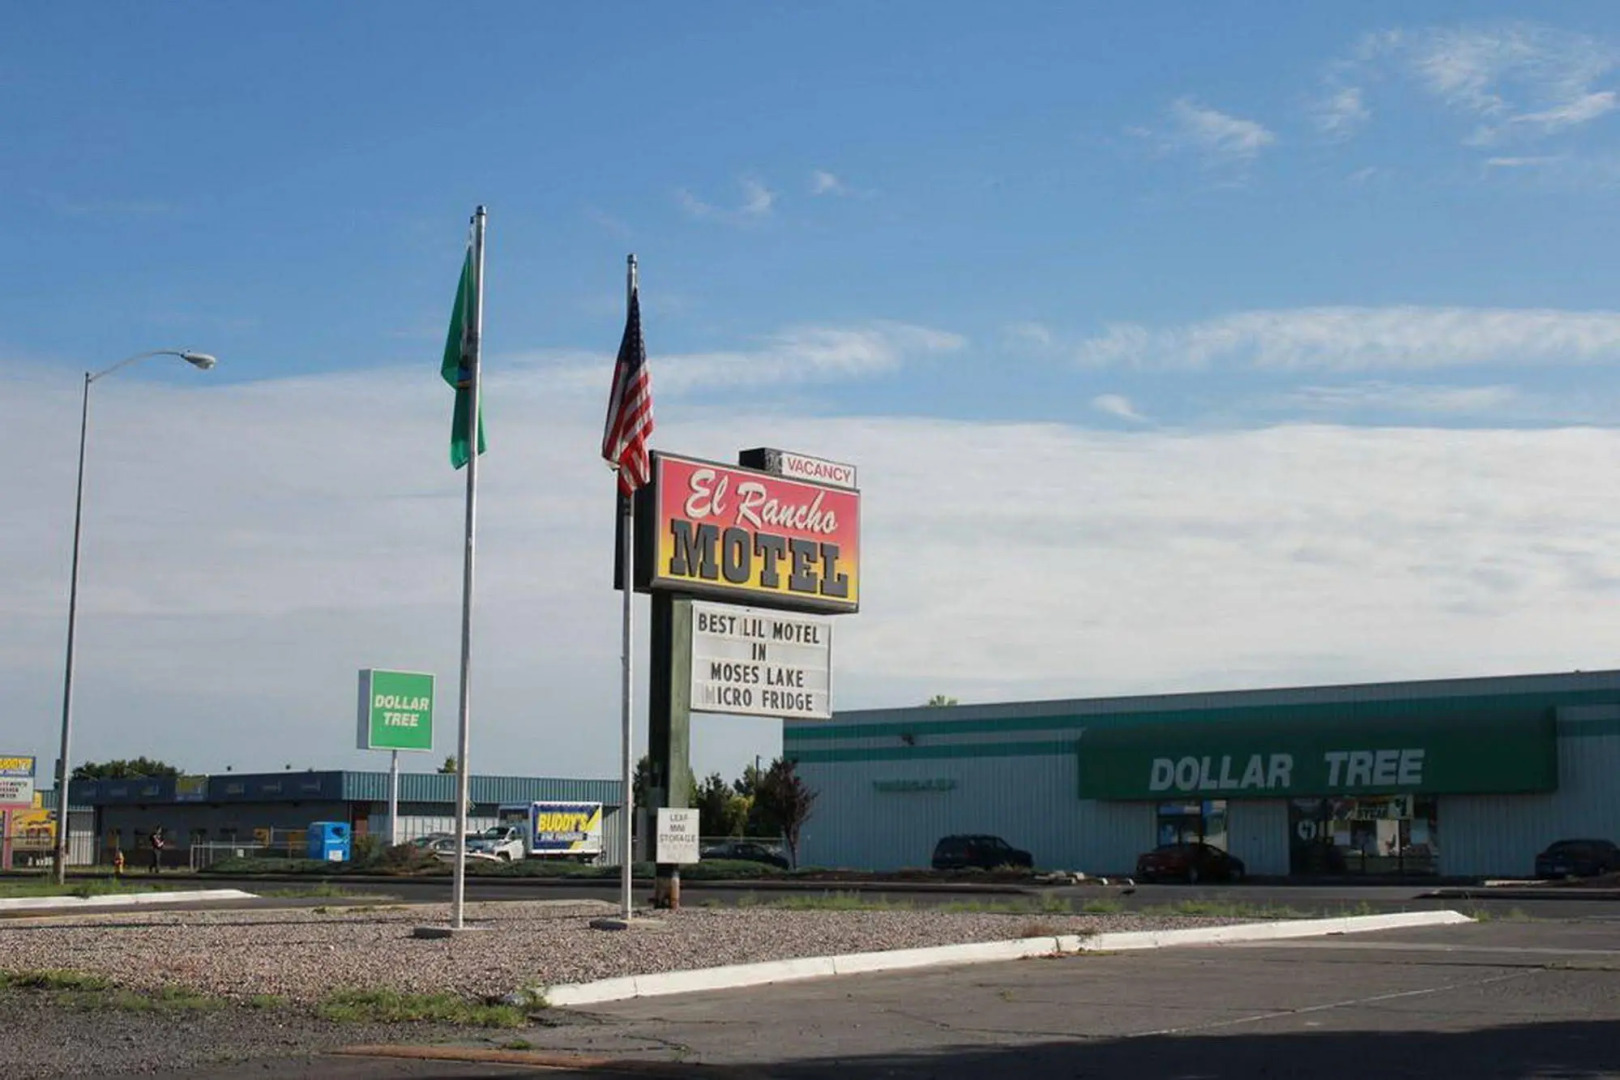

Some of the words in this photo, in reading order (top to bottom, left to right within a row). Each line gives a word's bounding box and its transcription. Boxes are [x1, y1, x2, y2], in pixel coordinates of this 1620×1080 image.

[787, 456, 852, 483] VACANCY
[685, 468, 728, 518] El
[736, 481, 838, 534] Rancho
[669, 518, 848, 598] MOTEL
[698, 612, 736, 635] BEST
[743, 617, 765, 638] LIL
[772, 621, 820, 644] MOTEL
[751, 642, 767, 661] IN
[711, 661, 760, 684] MOSES
[767, 667, 804, 688] LAKE
[375, 694, 430, 711] DOLLAR
[762, 689, 813, 711] FRIDGE
[383, 711, 420, 727] TREE
[1149, 752, 1294, 792] DOLLAR
[1324, 748, 1426, 787] TREE
[537, 811, 589, 832] BUDDY'S
